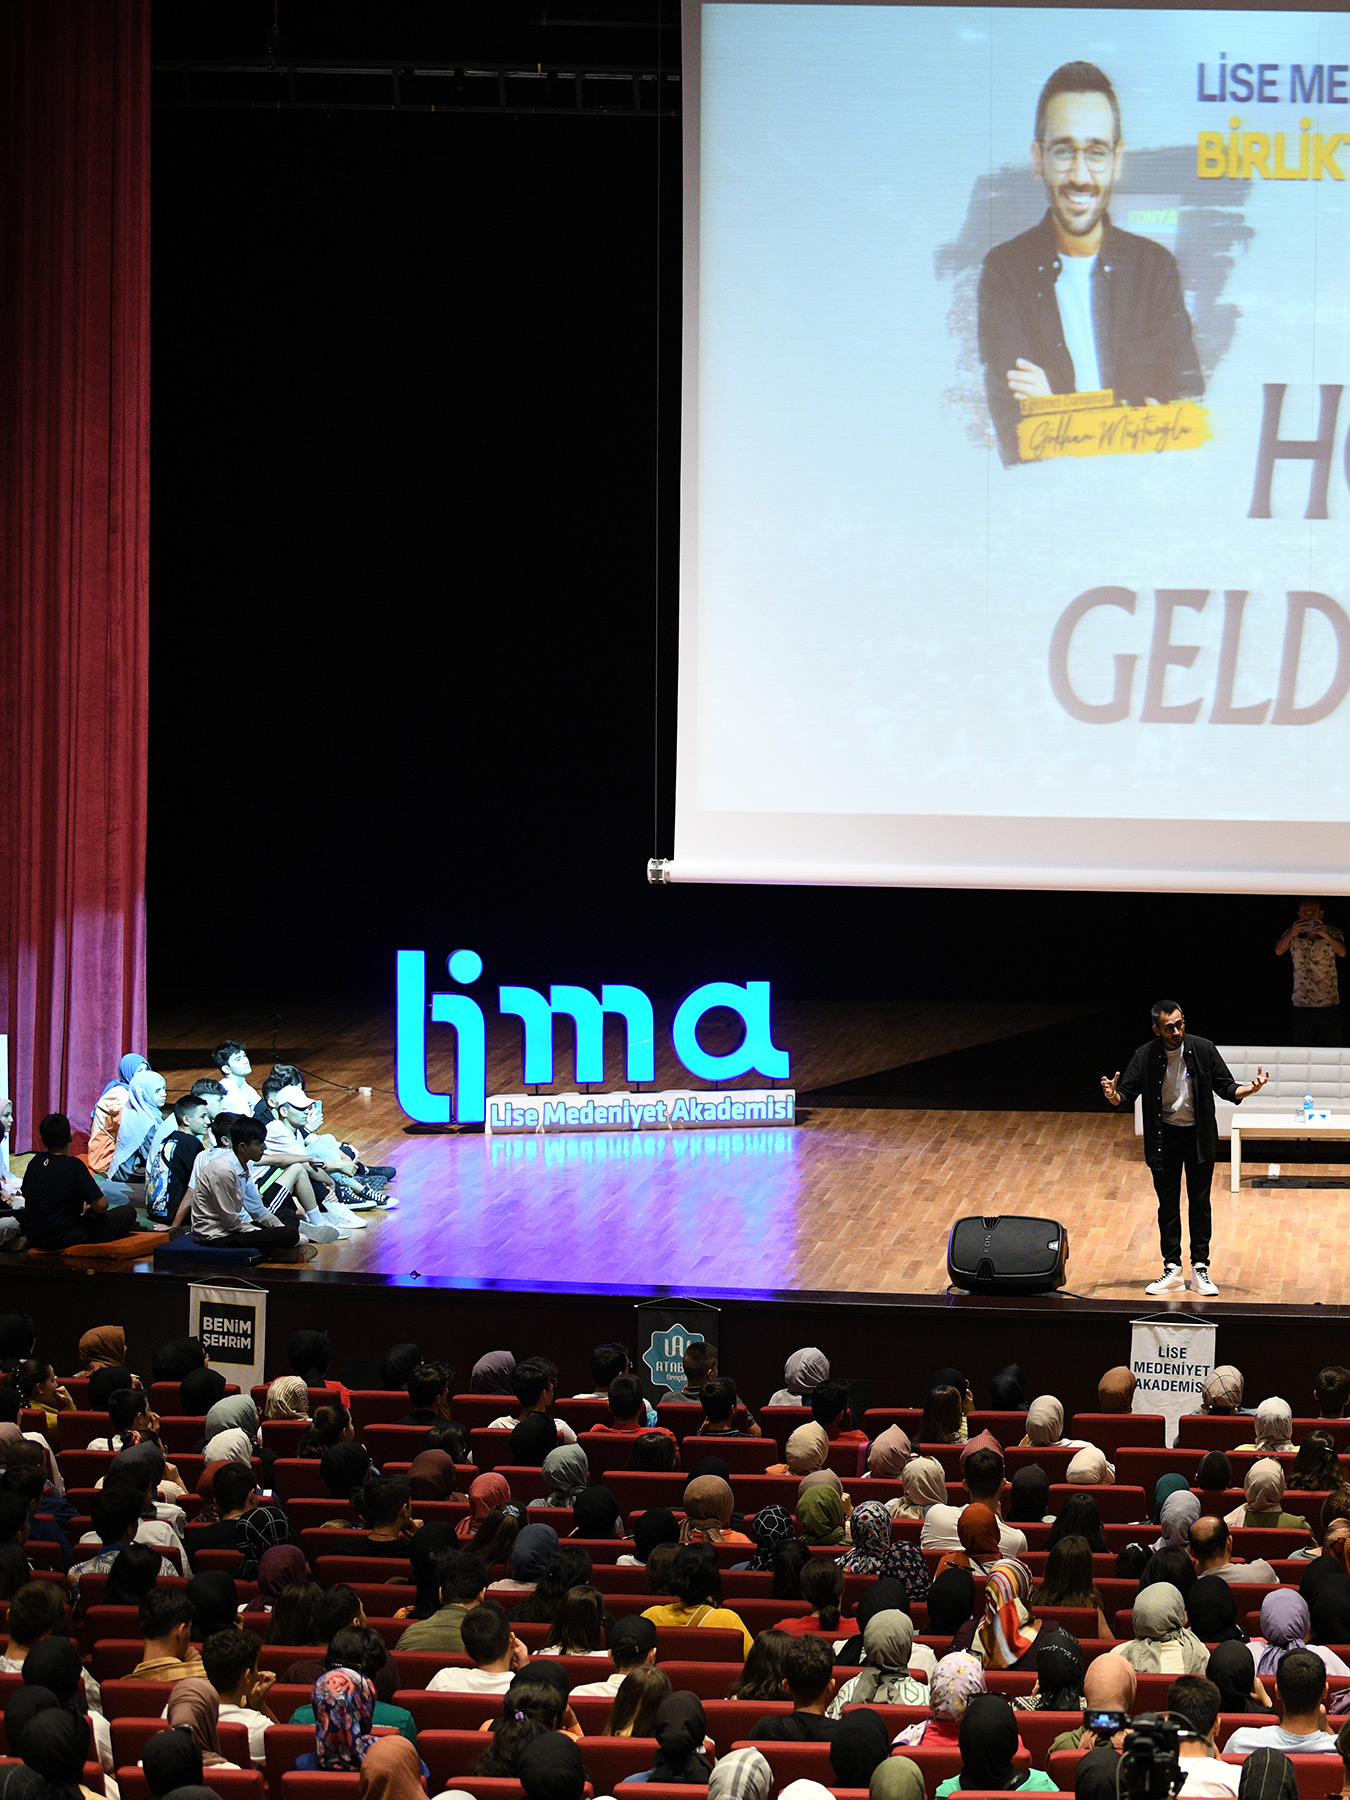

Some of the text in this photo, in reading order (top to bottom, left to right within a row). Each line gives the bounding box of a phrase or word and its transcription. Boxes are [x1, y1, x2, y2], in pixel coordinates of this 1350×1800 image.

[1197, 52, 1279, 103] LİSE
[490, 1095, 794, 1130] Lise Medeniyet Akademisi
[1158, 1344, 1187, 1359] LİSE
[656, 1360, 685, 1373] ATAB
[1133, 1361, 1210, 1377] MEDENİYET
[1134, 1378, 1204, 1394] AKADEMİS
